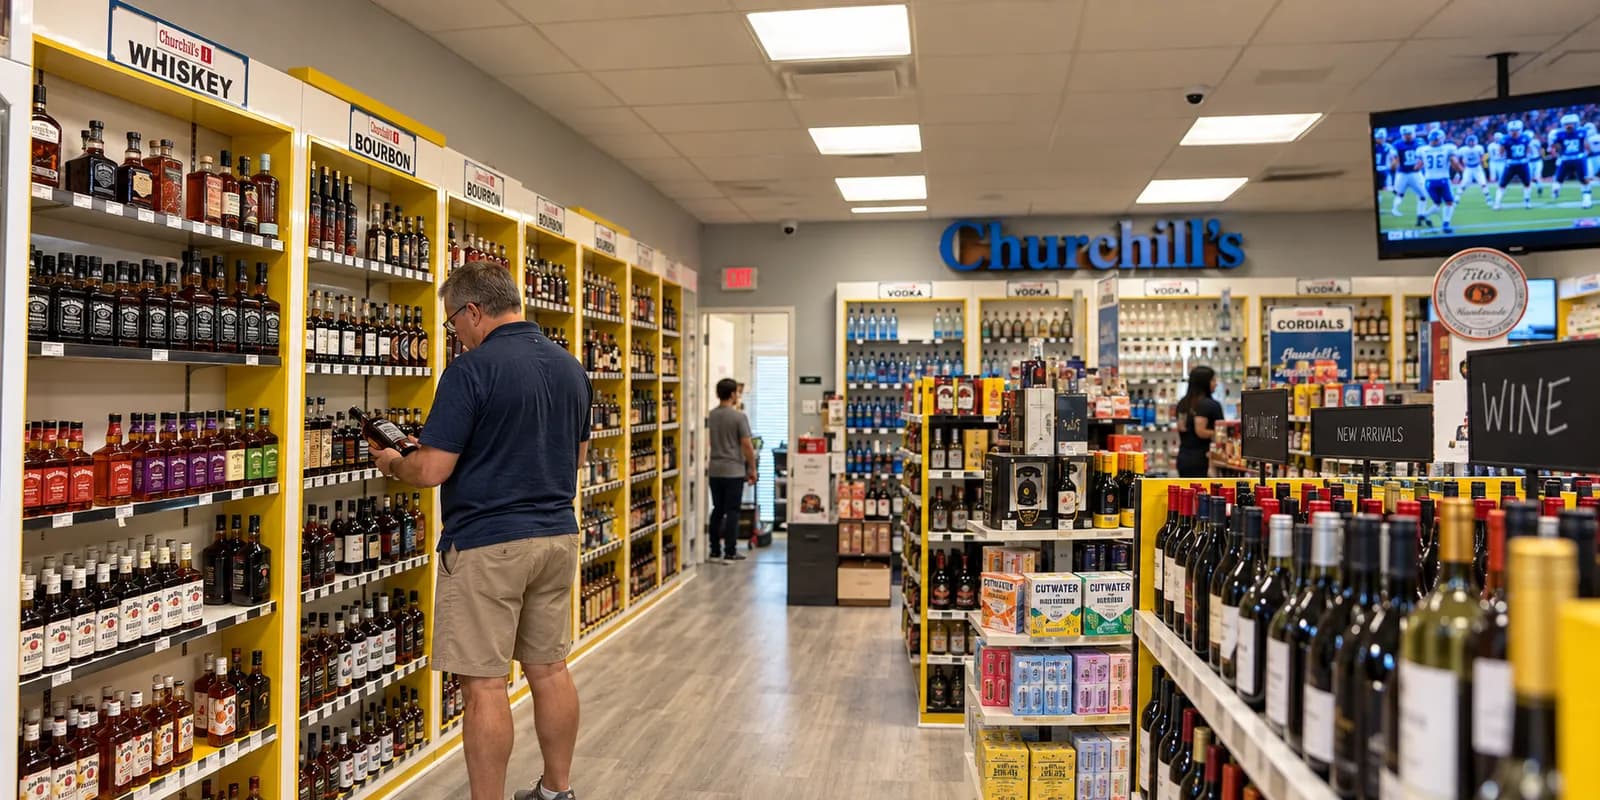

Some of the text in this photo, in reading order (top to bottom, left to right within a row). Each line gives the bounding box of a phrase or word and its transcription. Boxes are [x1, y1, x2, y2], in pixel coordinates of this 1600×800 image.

[128, 40, 233, 99] WHISKEY
[355, 132, 411, 171] BOURBON
[467, 181, 501, 208] BOURBON
[938, 217, 1247, 271] Churchill's
[1462, 268, 1502, 281] Tito's
[887, 289, 923, 297] VODKA
[1015, 288, 1050, 297] VODKA
[1305, 285, 1343, 294] VODKA
[1277, 319, 1345, 330] CORDIALS
[1481, 376, 1572, 436] WINE
[1336, 426, 1404, 443] NEW ARRIVALS
[1035, 583, 1079, 593] CUTWATER
[1089, 582, 1131, 593] CUTWATER
